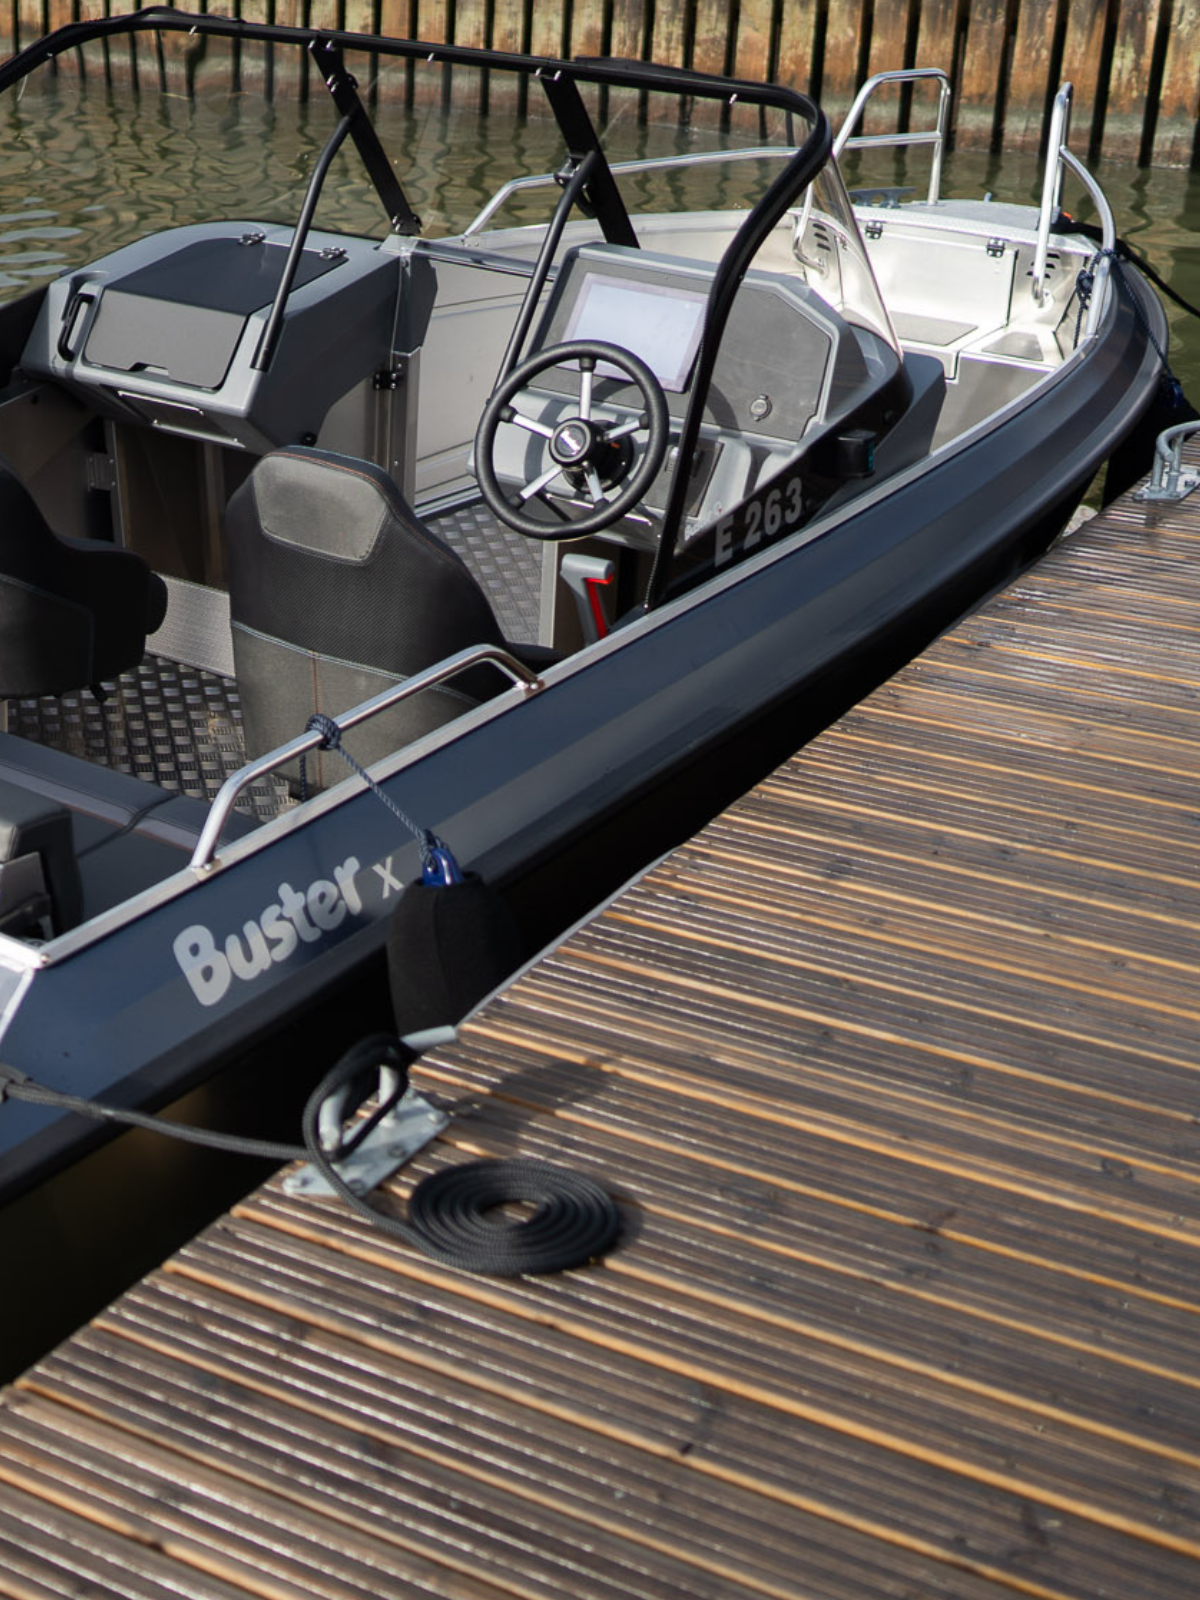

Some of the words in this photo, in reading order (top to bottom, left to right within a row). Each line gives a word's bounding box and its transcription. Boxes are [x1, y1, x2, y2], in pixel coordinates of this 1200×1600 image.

[714, 514, 735, 567] E
[743, 477, 803, 551] 263
[173, 856, 363, 1007] Buster
